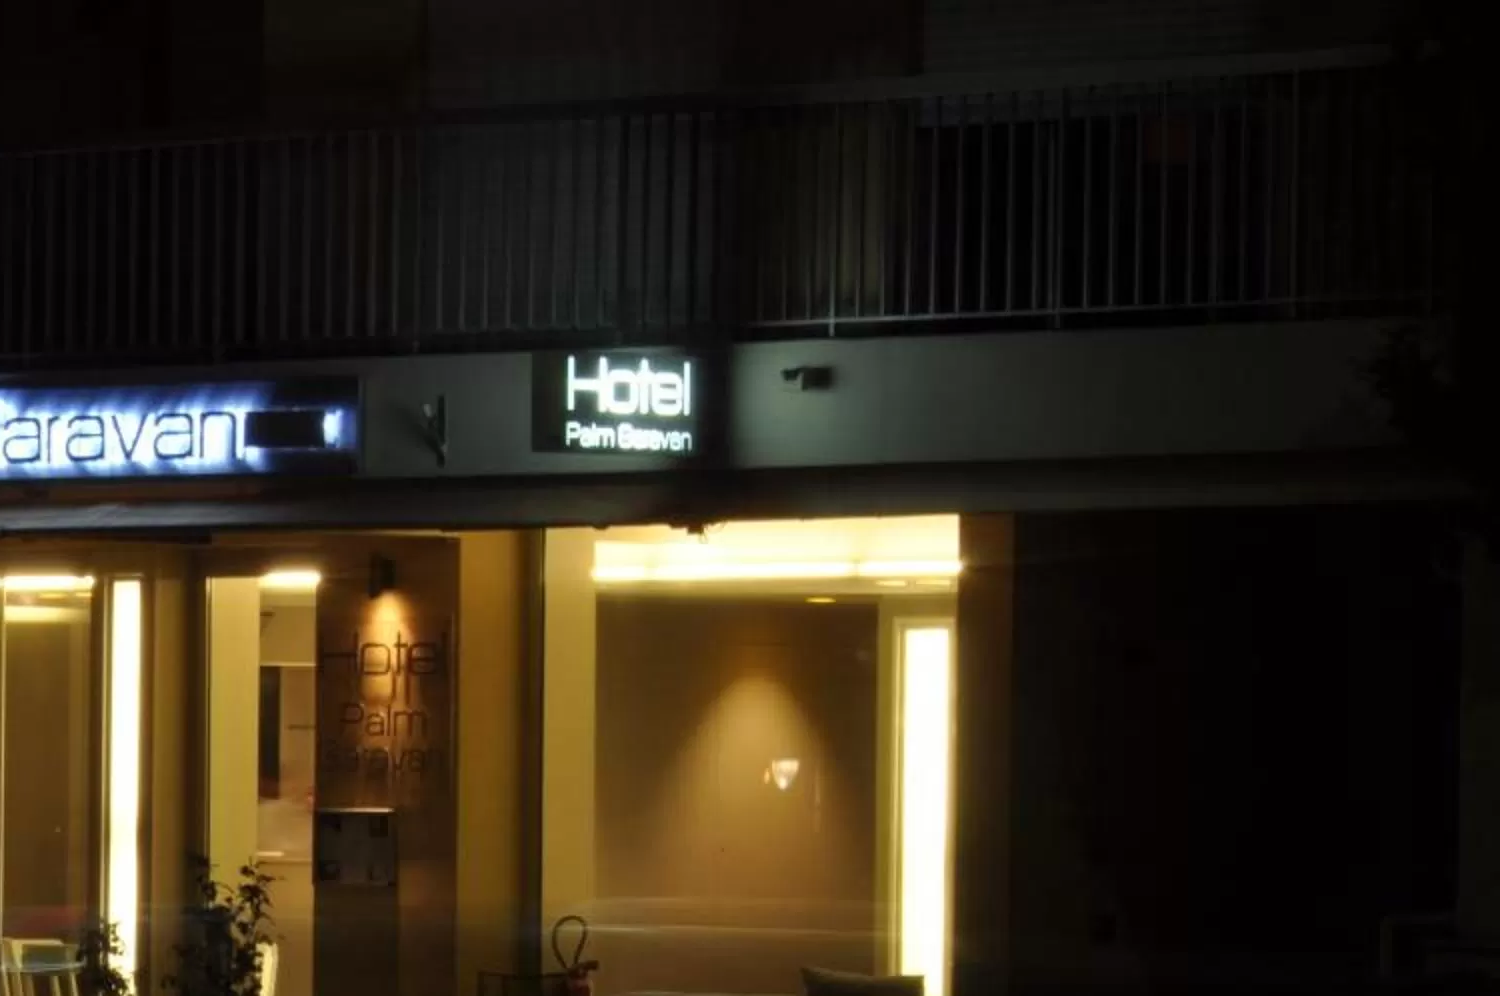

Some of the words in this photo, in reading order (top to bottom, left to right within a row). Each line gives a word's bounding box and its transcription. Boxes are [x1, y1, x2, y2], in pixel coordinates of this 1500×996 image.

[566, 355, 692, 416] Hotel
[566, 421, 616, 449] Palm
[320, 630, 449, 676] Hotel
[338, 701, 429, 737] Palm
